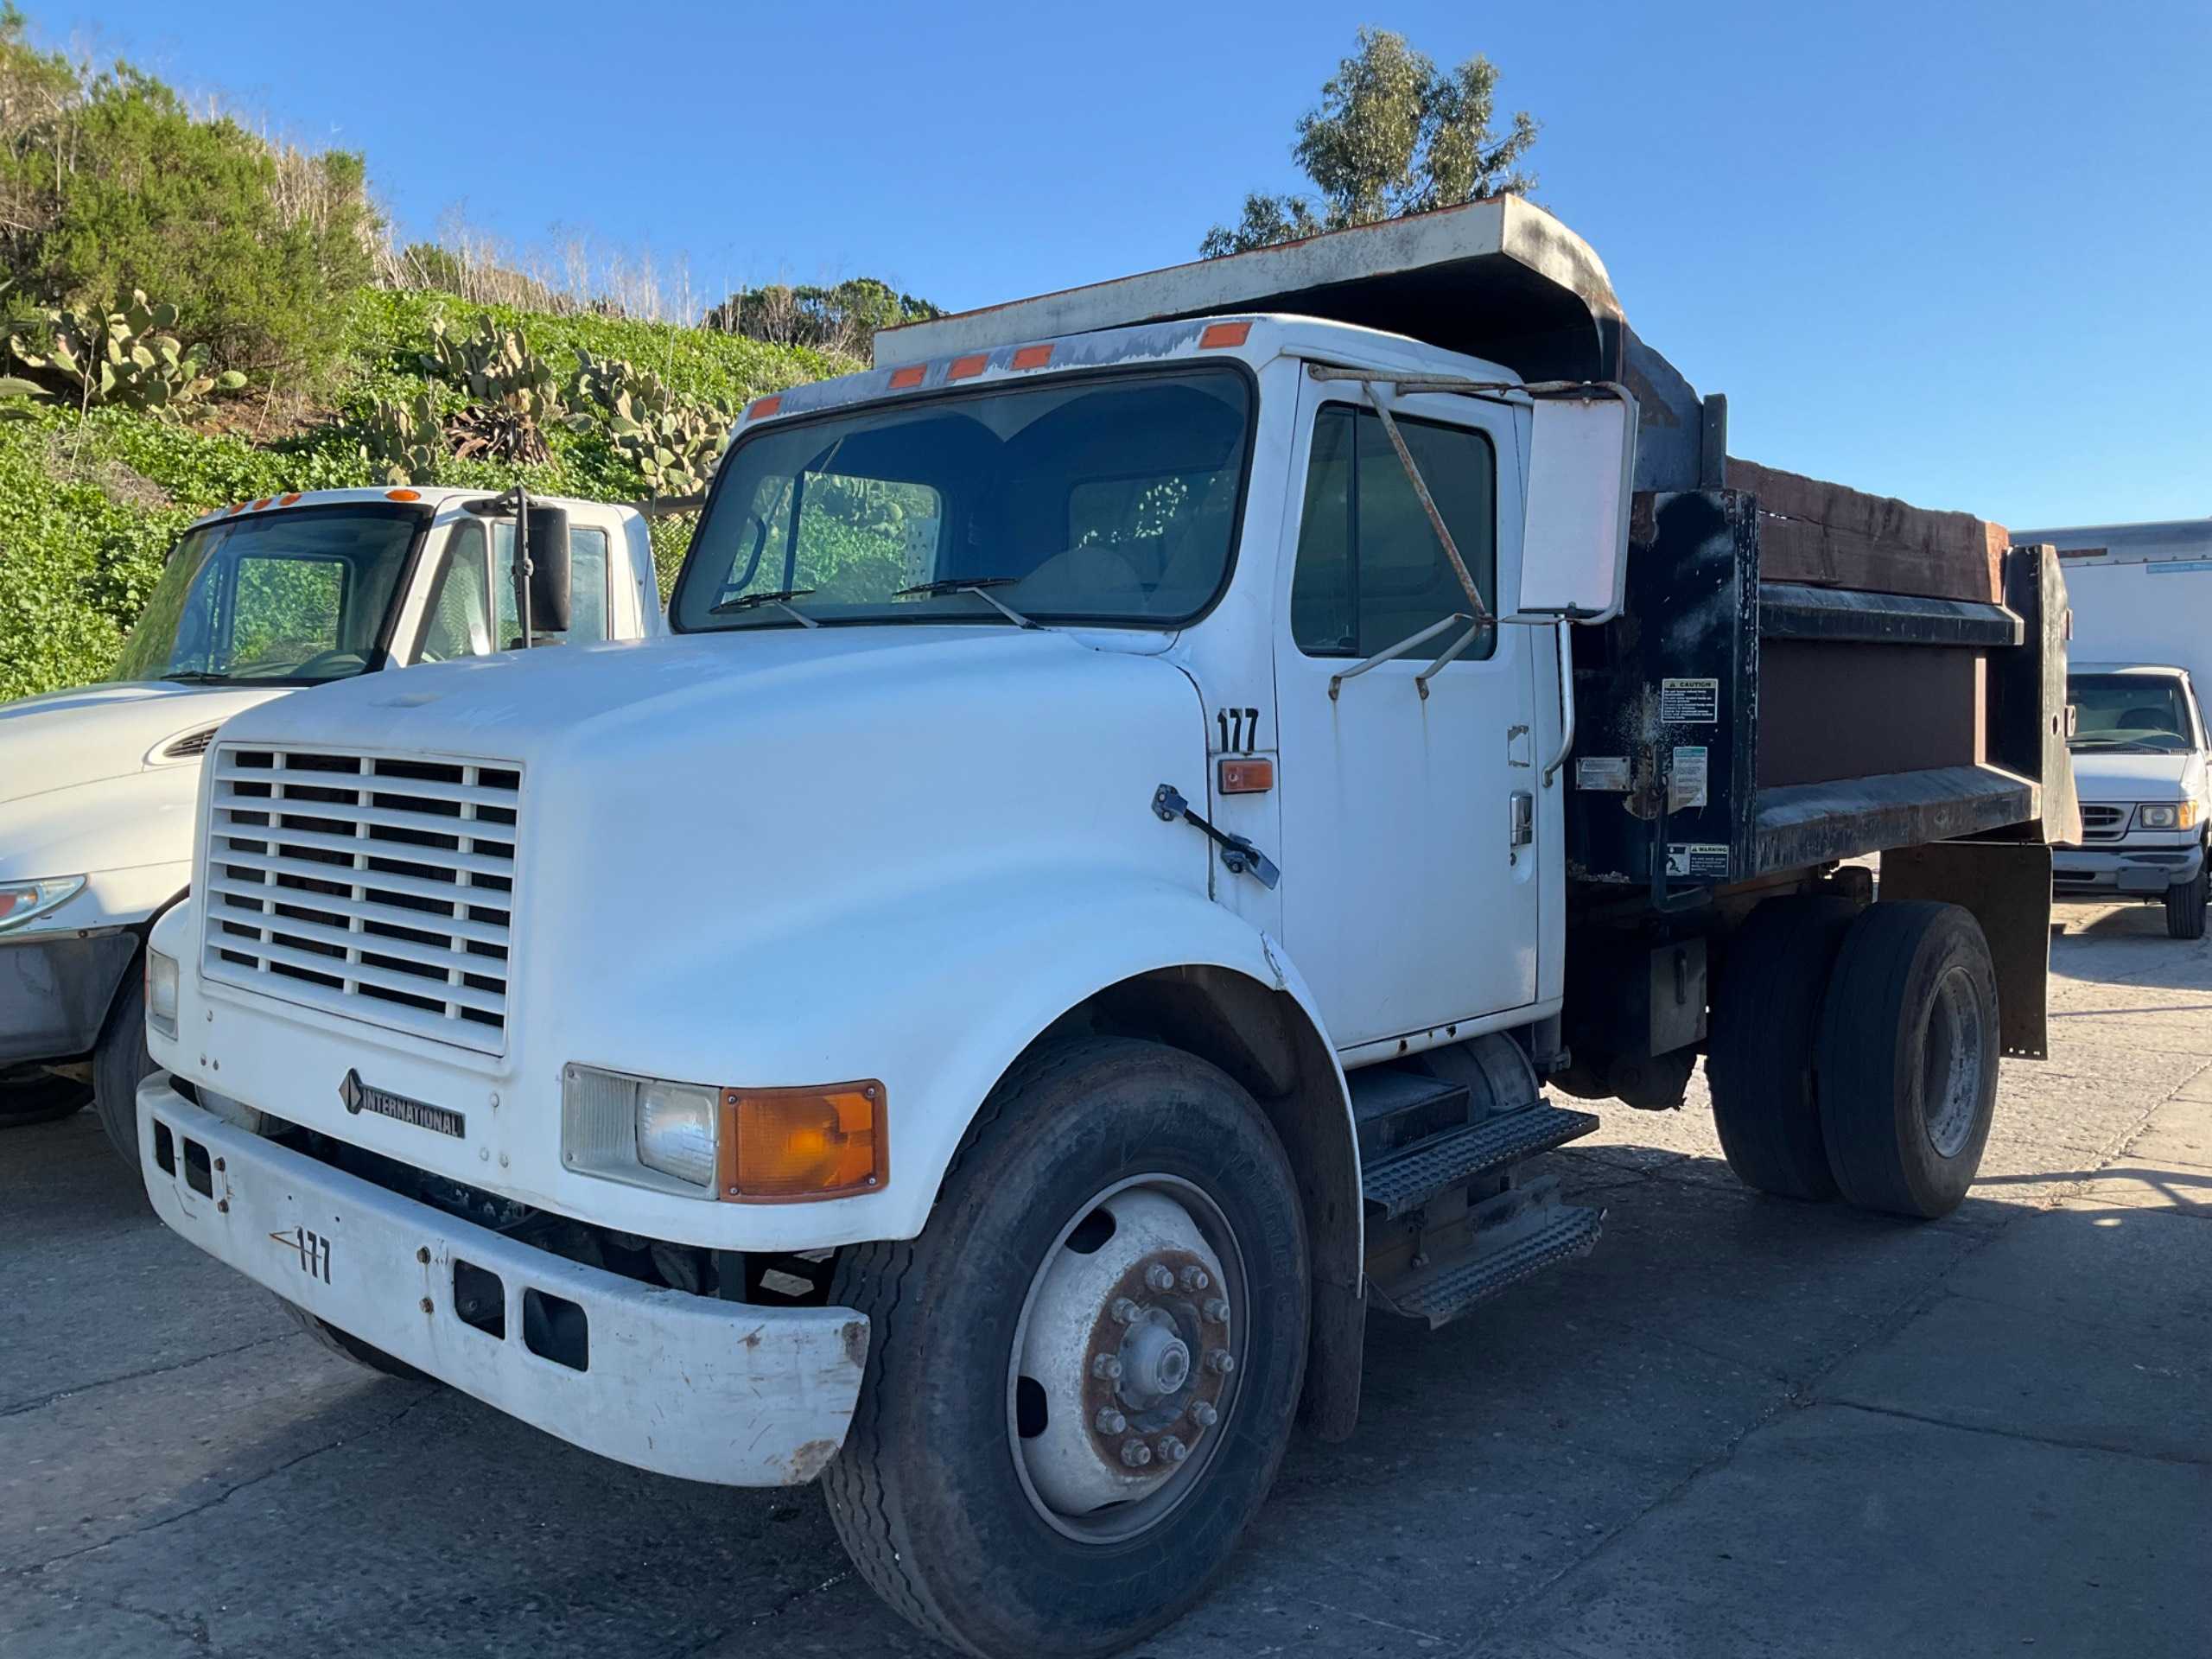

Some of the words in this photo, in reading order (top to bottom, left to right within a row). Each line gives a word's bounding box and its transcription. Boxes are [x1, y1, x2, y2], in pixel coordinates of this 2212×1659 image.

[1217, 708, 1259, 755] 177
[363, 1089, 458, 1136] INTERNATIONAL
[296, 1226, 331, 1286] 177
